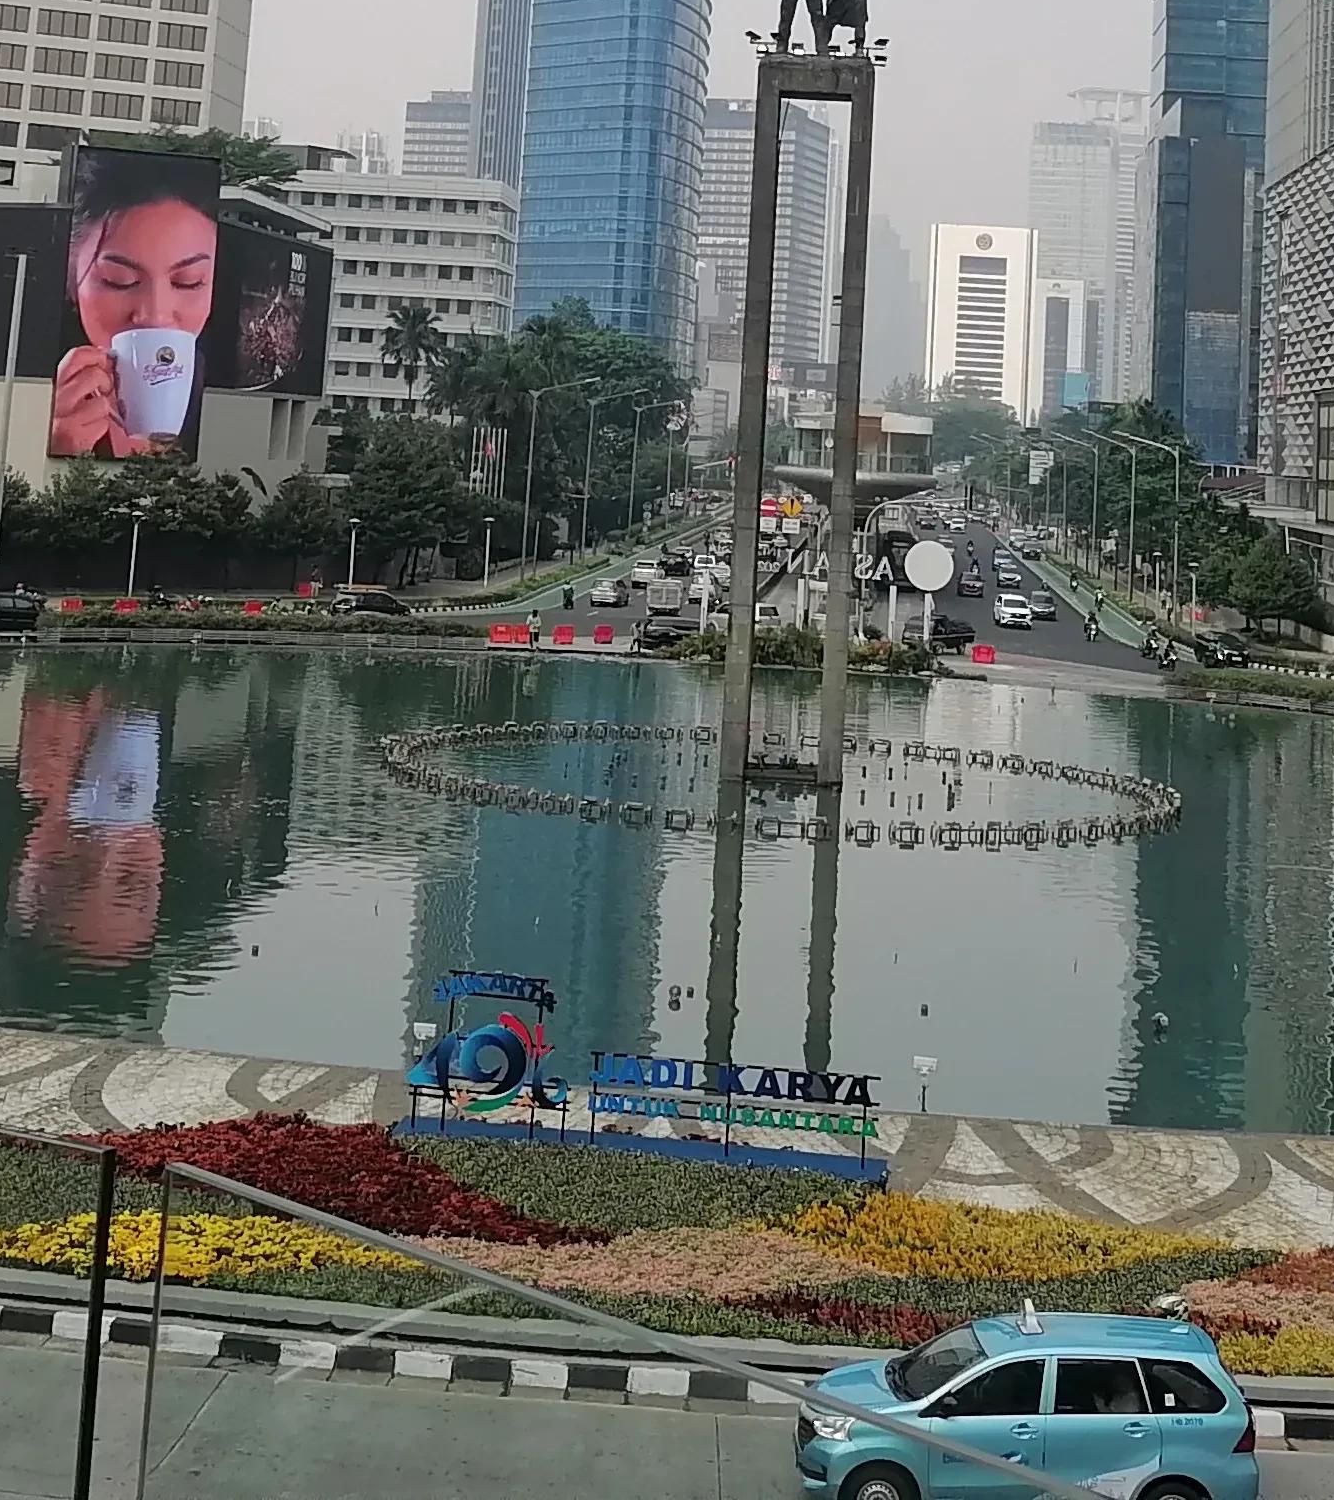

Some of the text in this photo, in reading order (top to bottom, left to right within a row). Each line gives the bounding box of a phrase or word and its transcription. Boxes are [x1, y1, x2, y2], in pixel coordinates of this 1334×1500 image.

[433, 971, 555, 1014] JAKARTA
[588, 1053, 873, 1106] JADI KARYA
[587, 1090, 880, 1139] UNTUK NUSANTARA
